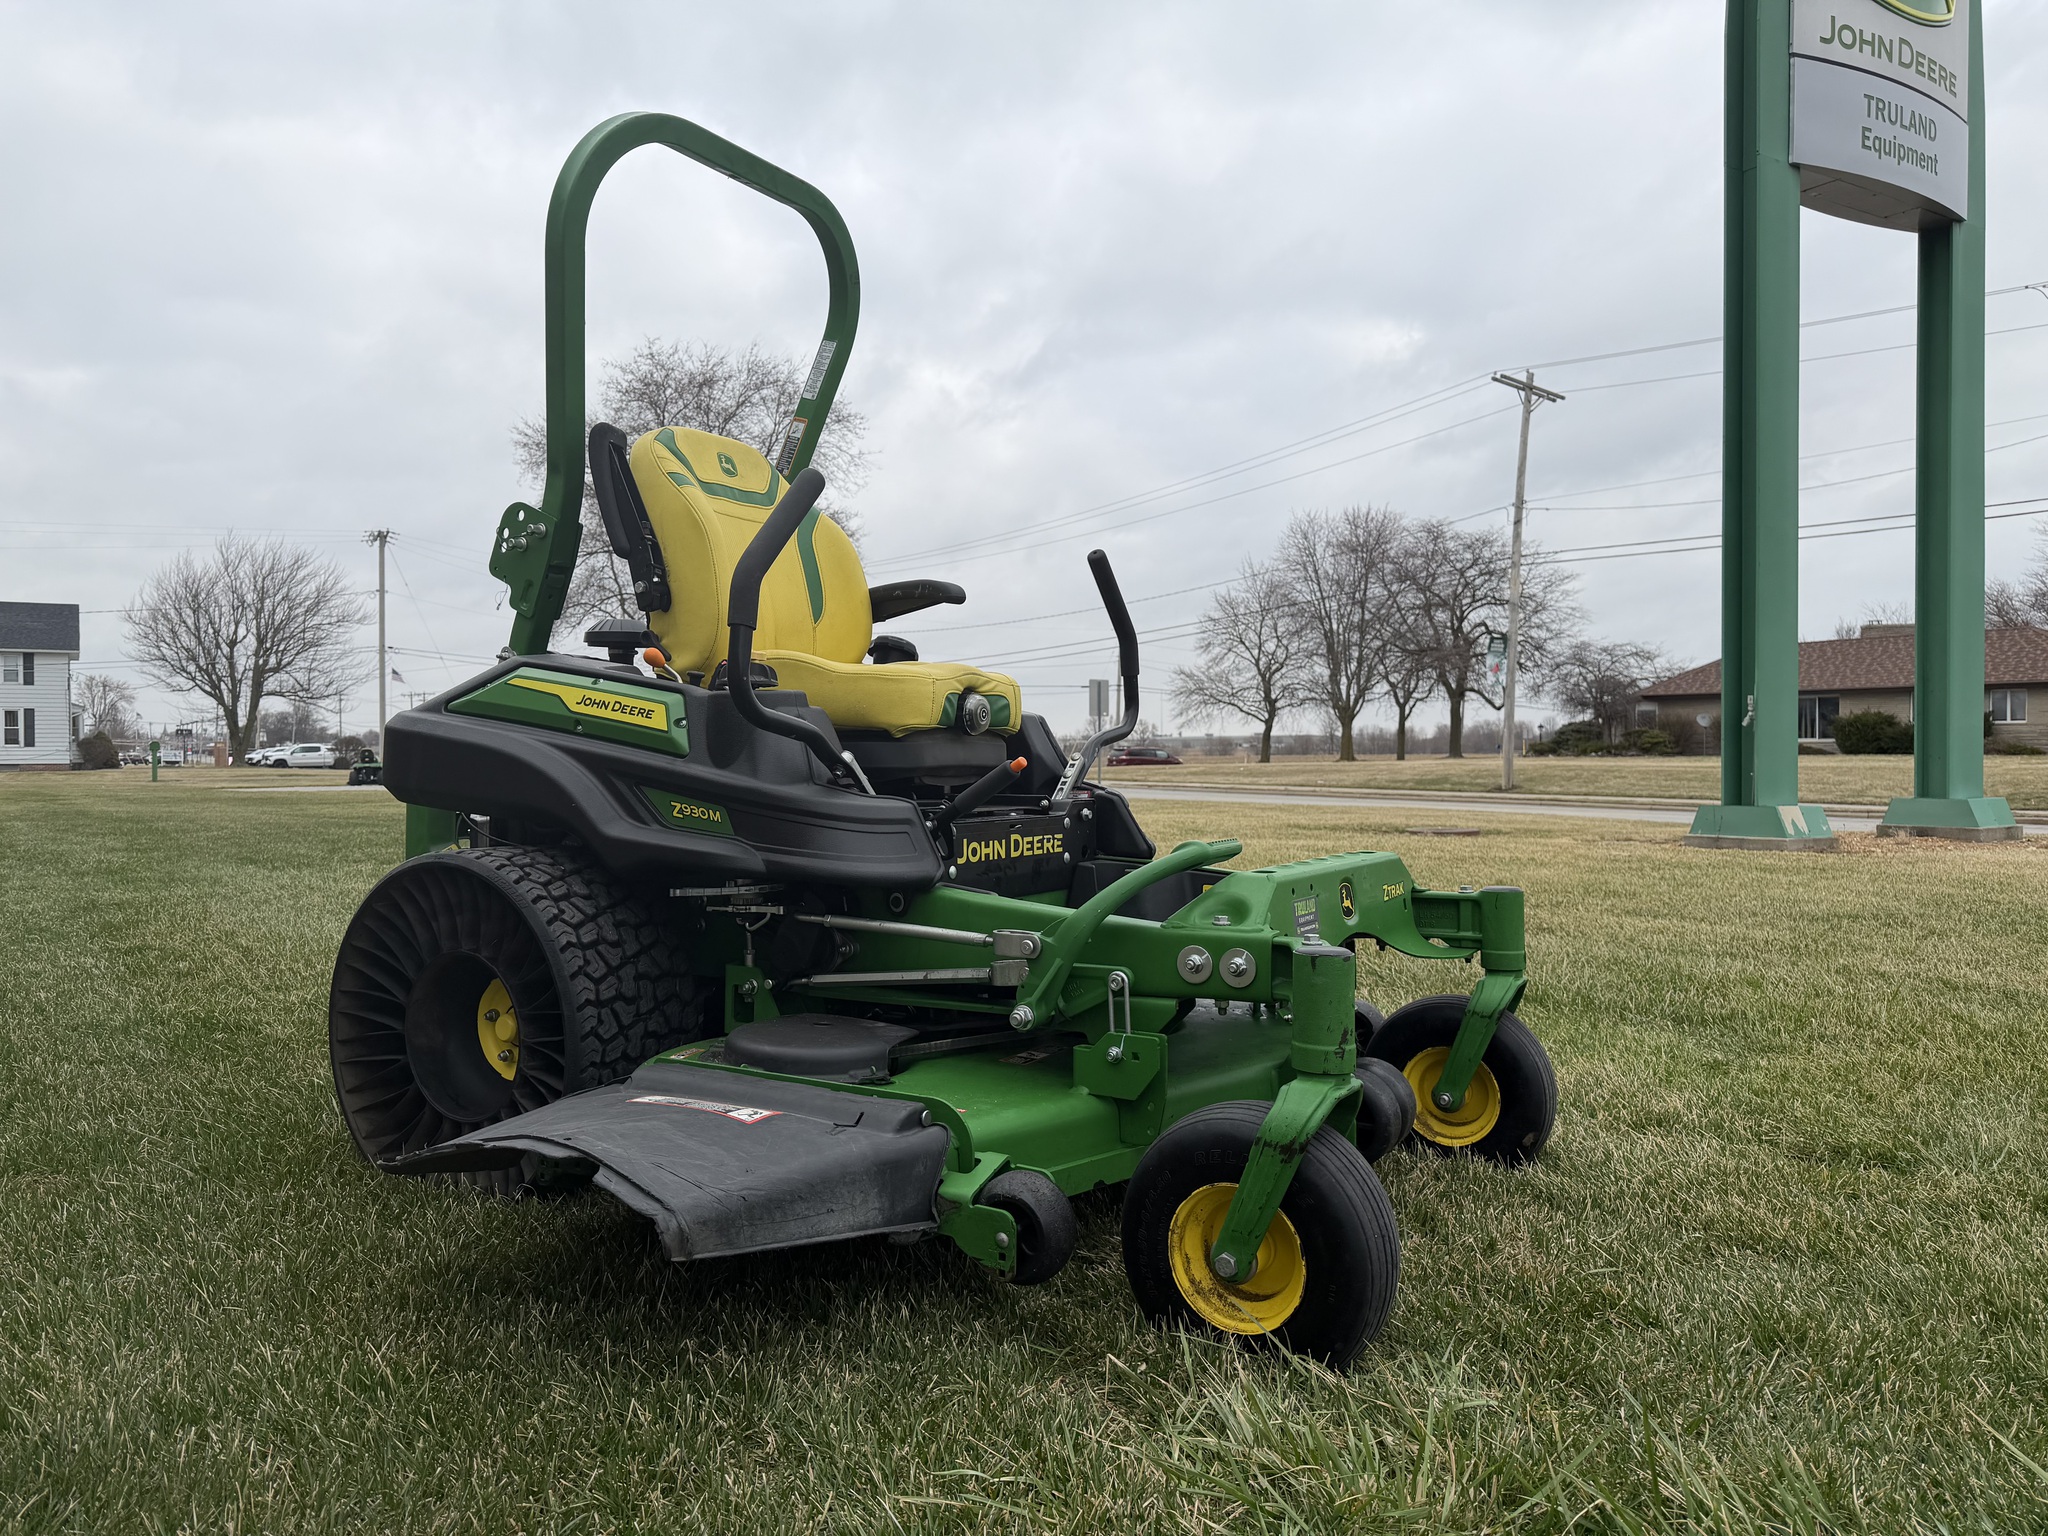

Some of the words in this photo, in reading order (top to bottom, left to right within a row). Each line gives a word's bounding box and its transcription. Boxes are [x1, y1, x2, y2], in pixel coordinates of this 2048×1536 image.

[1819, 15, 1894, 64] JOHN
[1898, 36, 1957, 99] DEERE
[1863, 93, 1937, 143] TRULAND
[1861, 126, 1939, 176] Equipment
[576, 695, 610, 710] JOHN
[611, 700, 655, 719] DEERE
[670, 801, 721, 823] Z930M
[956, 838, 1006, 865] JOHN
[1010, 833, 1064, 858] DEERE
[1382, 881, 1405, 902] ZTRAK
